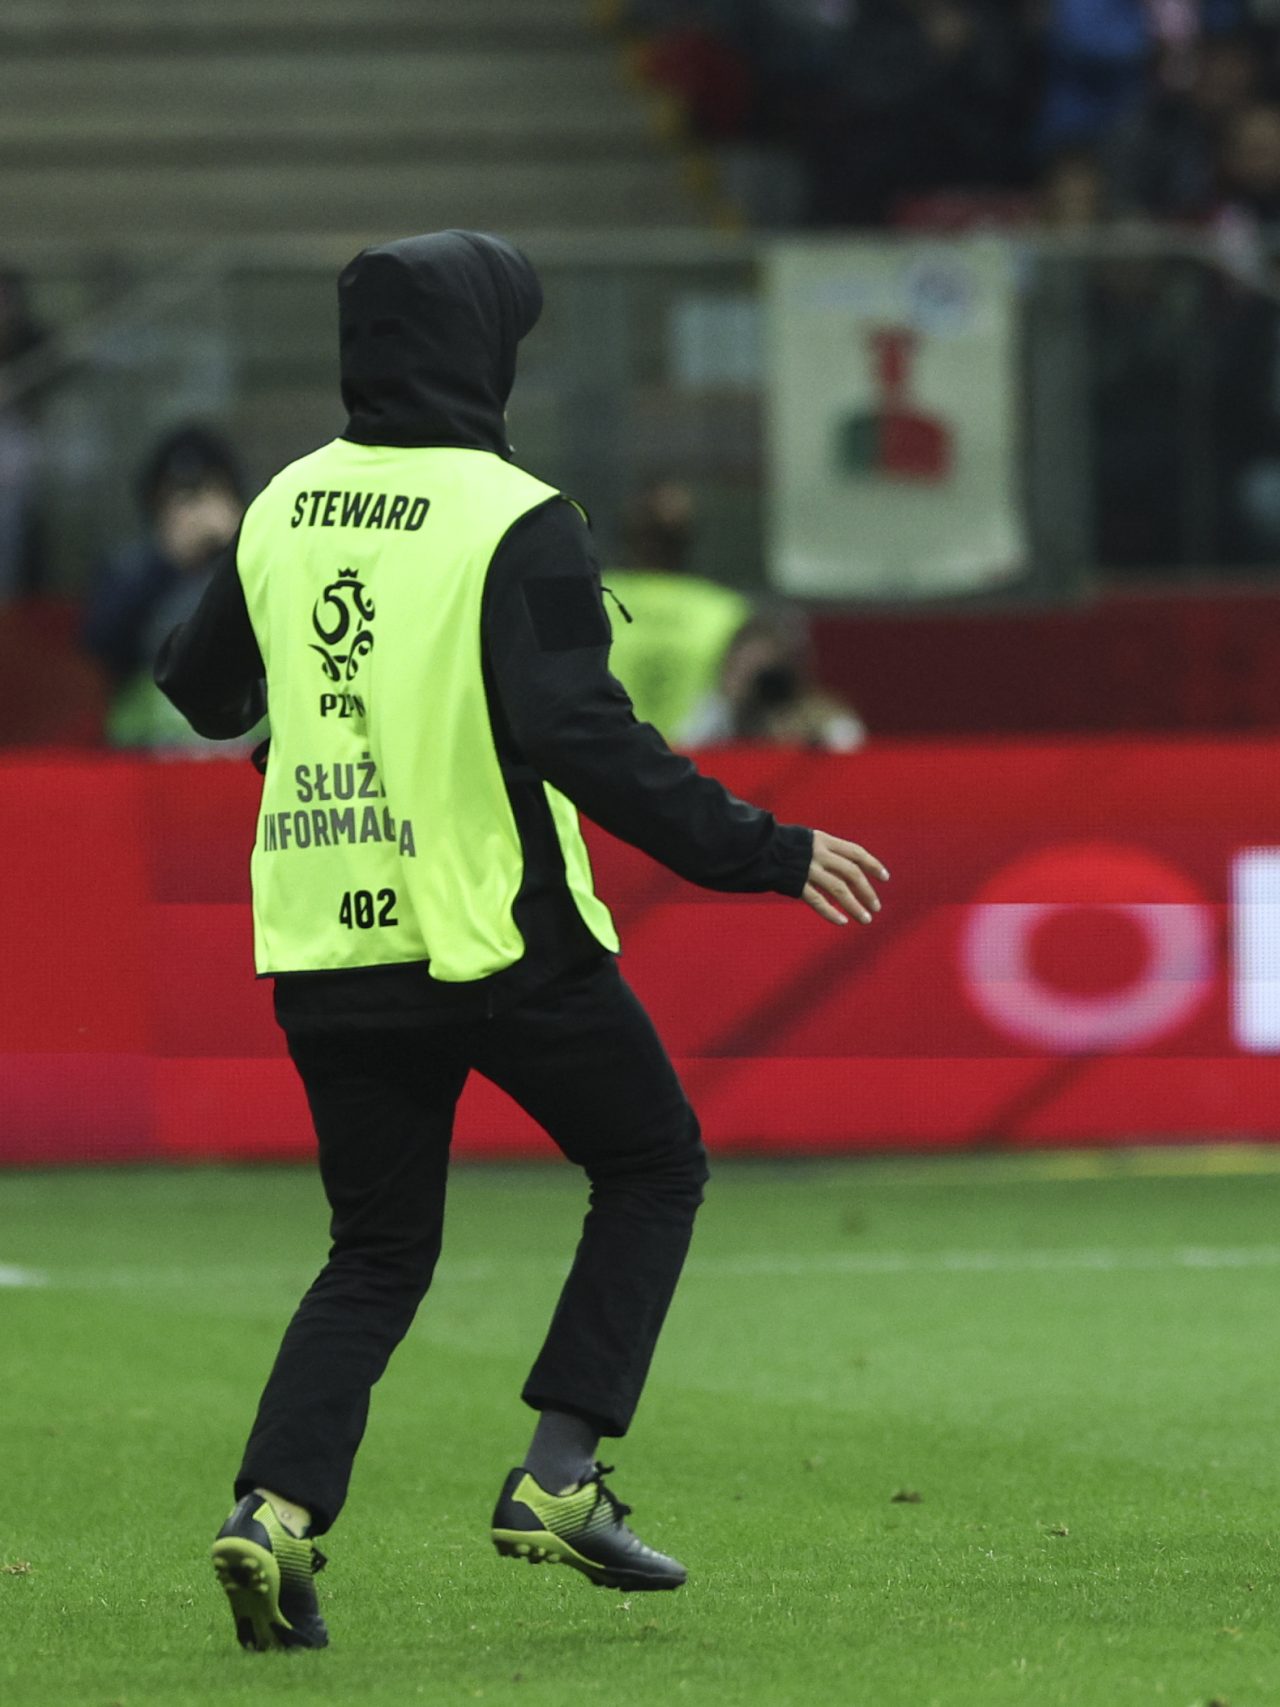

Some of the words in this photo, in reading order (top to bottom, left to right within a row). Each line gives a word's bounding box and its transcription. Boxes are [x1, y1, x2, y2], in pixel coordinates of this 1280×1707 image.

[291, 490, 430, 531] STEWARD
[320, 693, 366, 718] PZN
[295, 752, 386, 803] SŁUŻ
[339, 888, 398, 930] 402
